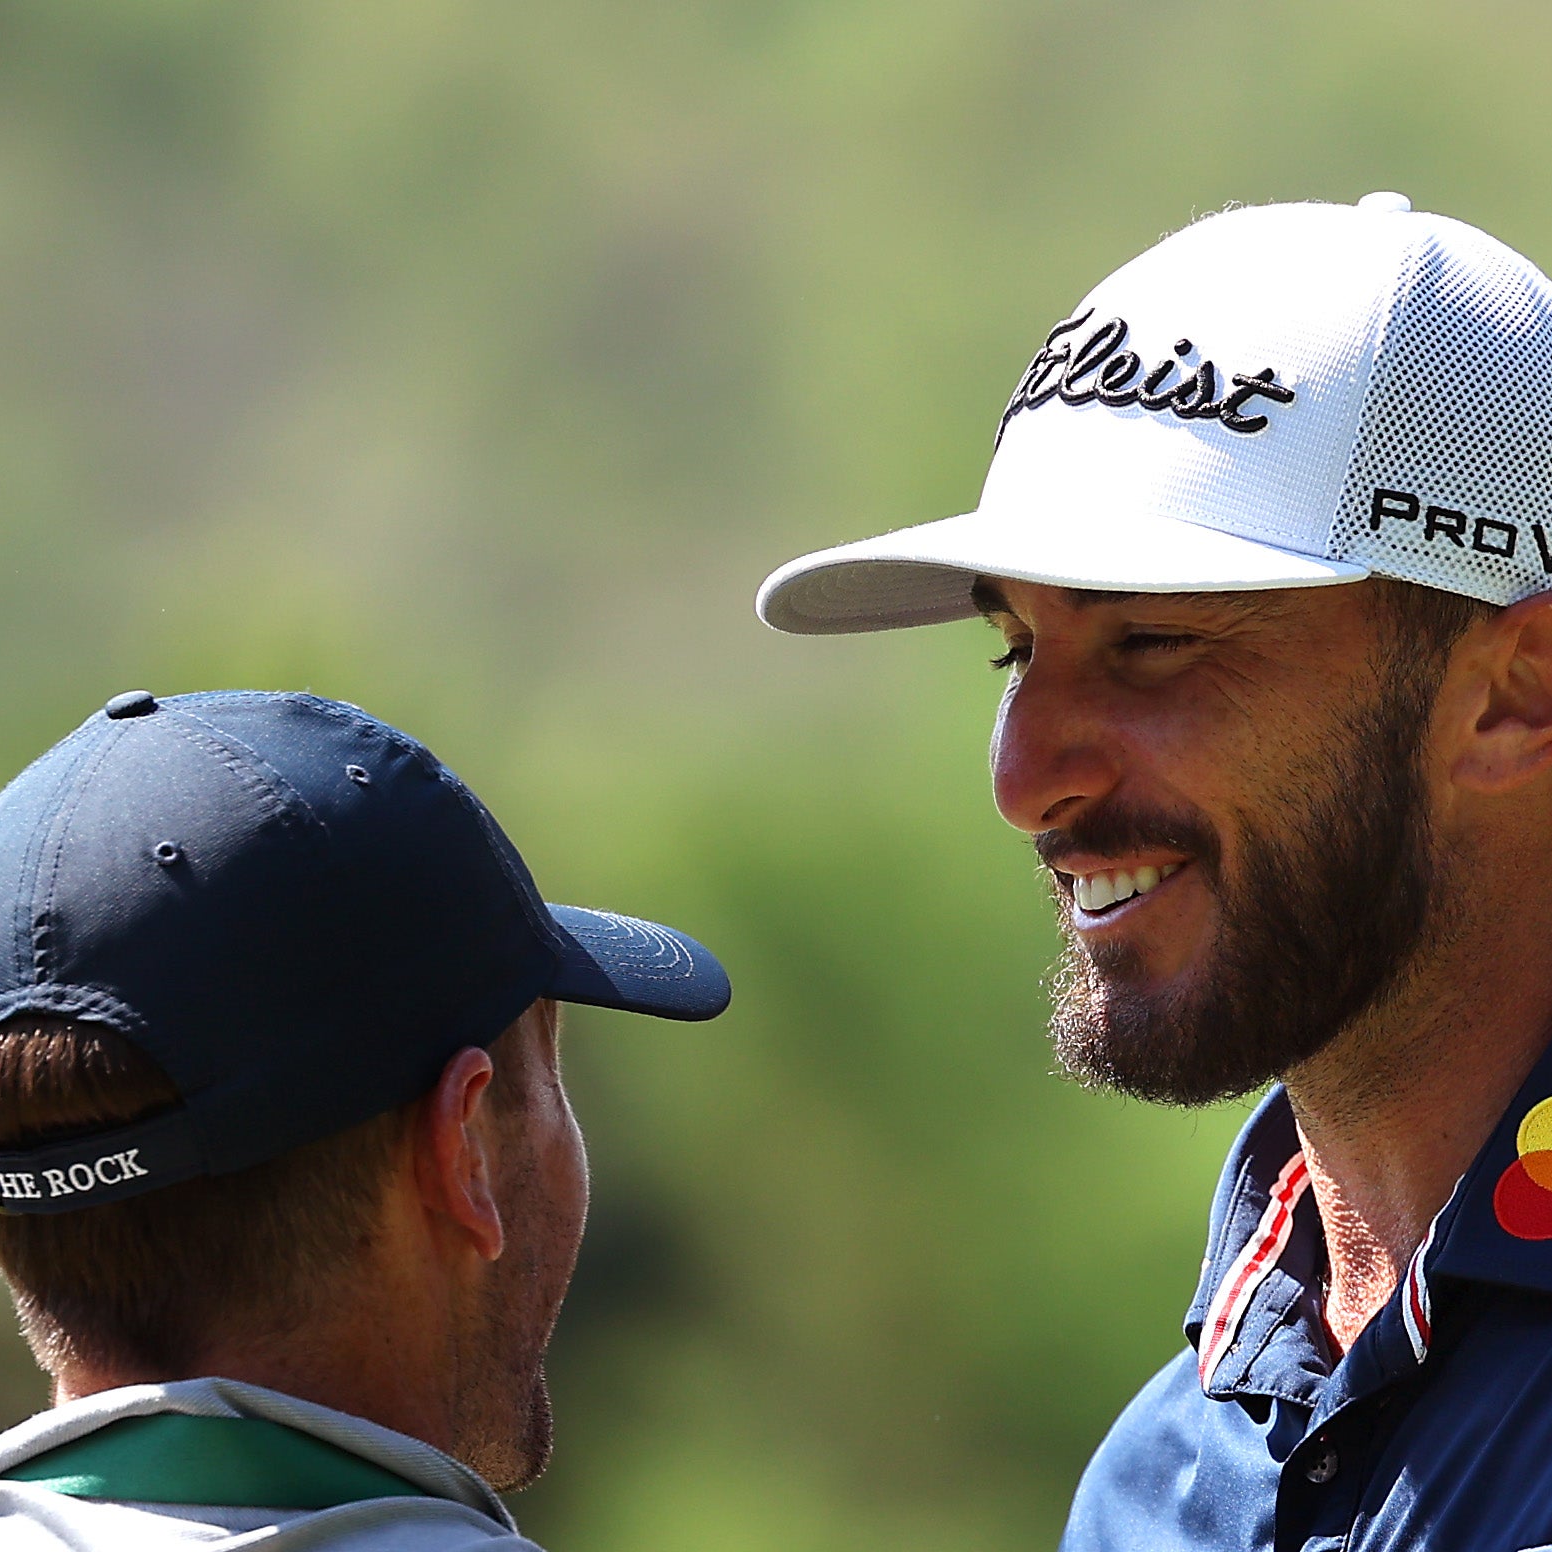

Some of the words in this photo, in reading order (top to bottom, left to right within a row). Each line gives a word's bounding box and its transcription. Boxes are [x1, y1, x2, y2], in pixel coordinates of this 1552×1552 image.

[994, 306, 1296, 434] tleist
[1368, 488, 1517, 557] PRO
[43, 1148, 149, 1198] ROCK
